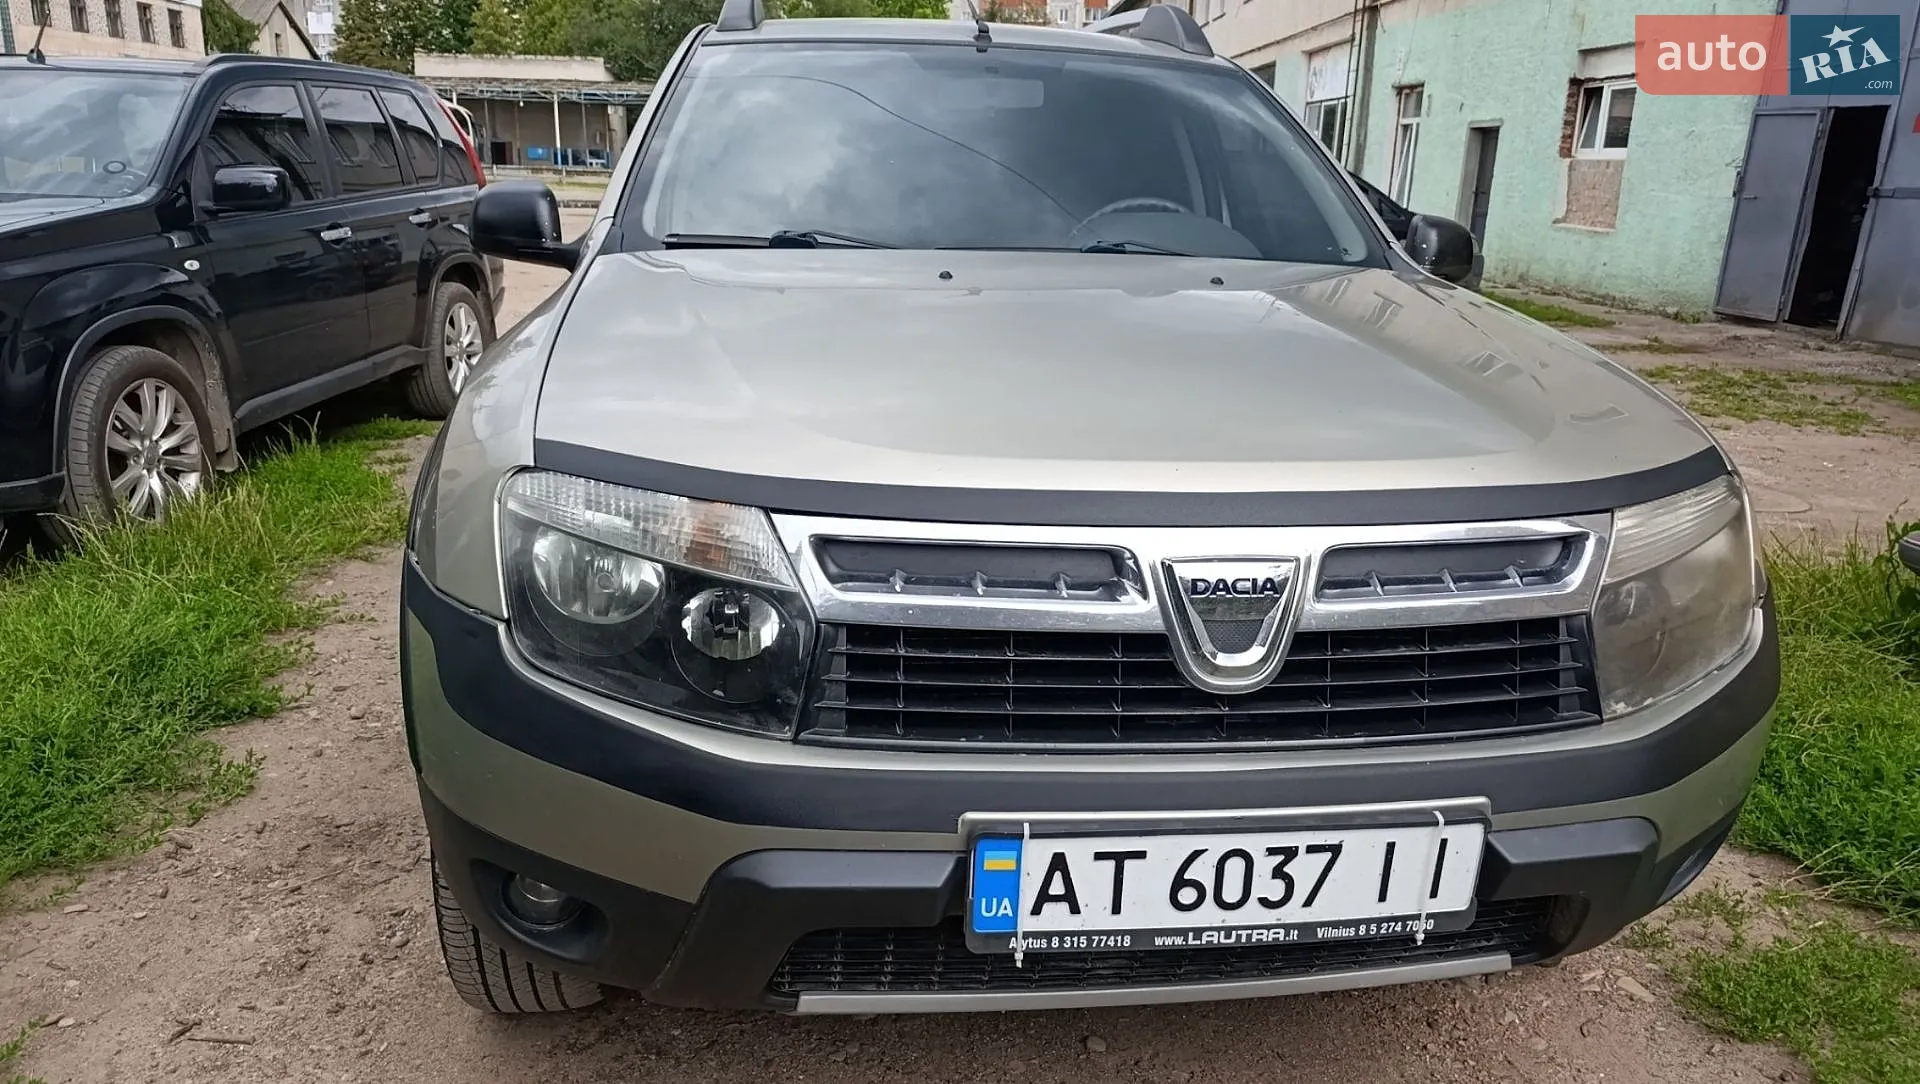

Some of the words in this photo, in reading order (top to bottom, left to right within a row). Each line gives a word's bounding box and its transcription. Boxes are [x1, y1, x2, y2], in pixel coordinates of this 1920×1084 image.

[1190, 577, 1281, 597] DACIA
[1030, 850, 1147, 916] AT
[1168, 839, 1344, 912] 6037
[981, 897, 1013, 918] UA
[1316, 924, 1356, 939] Vilnius
[1358, 924, 1367, 936] 8
[1369, 923, 1377, 934] 5
[1380, 921, 1402, 933] 274
[1009, 936, 1048, 950] Aytus
[1051, 936, 1060, 948] 8
[1063, 936, 1087, 948] 315
[1091, 935, 1131, 947] 77418
